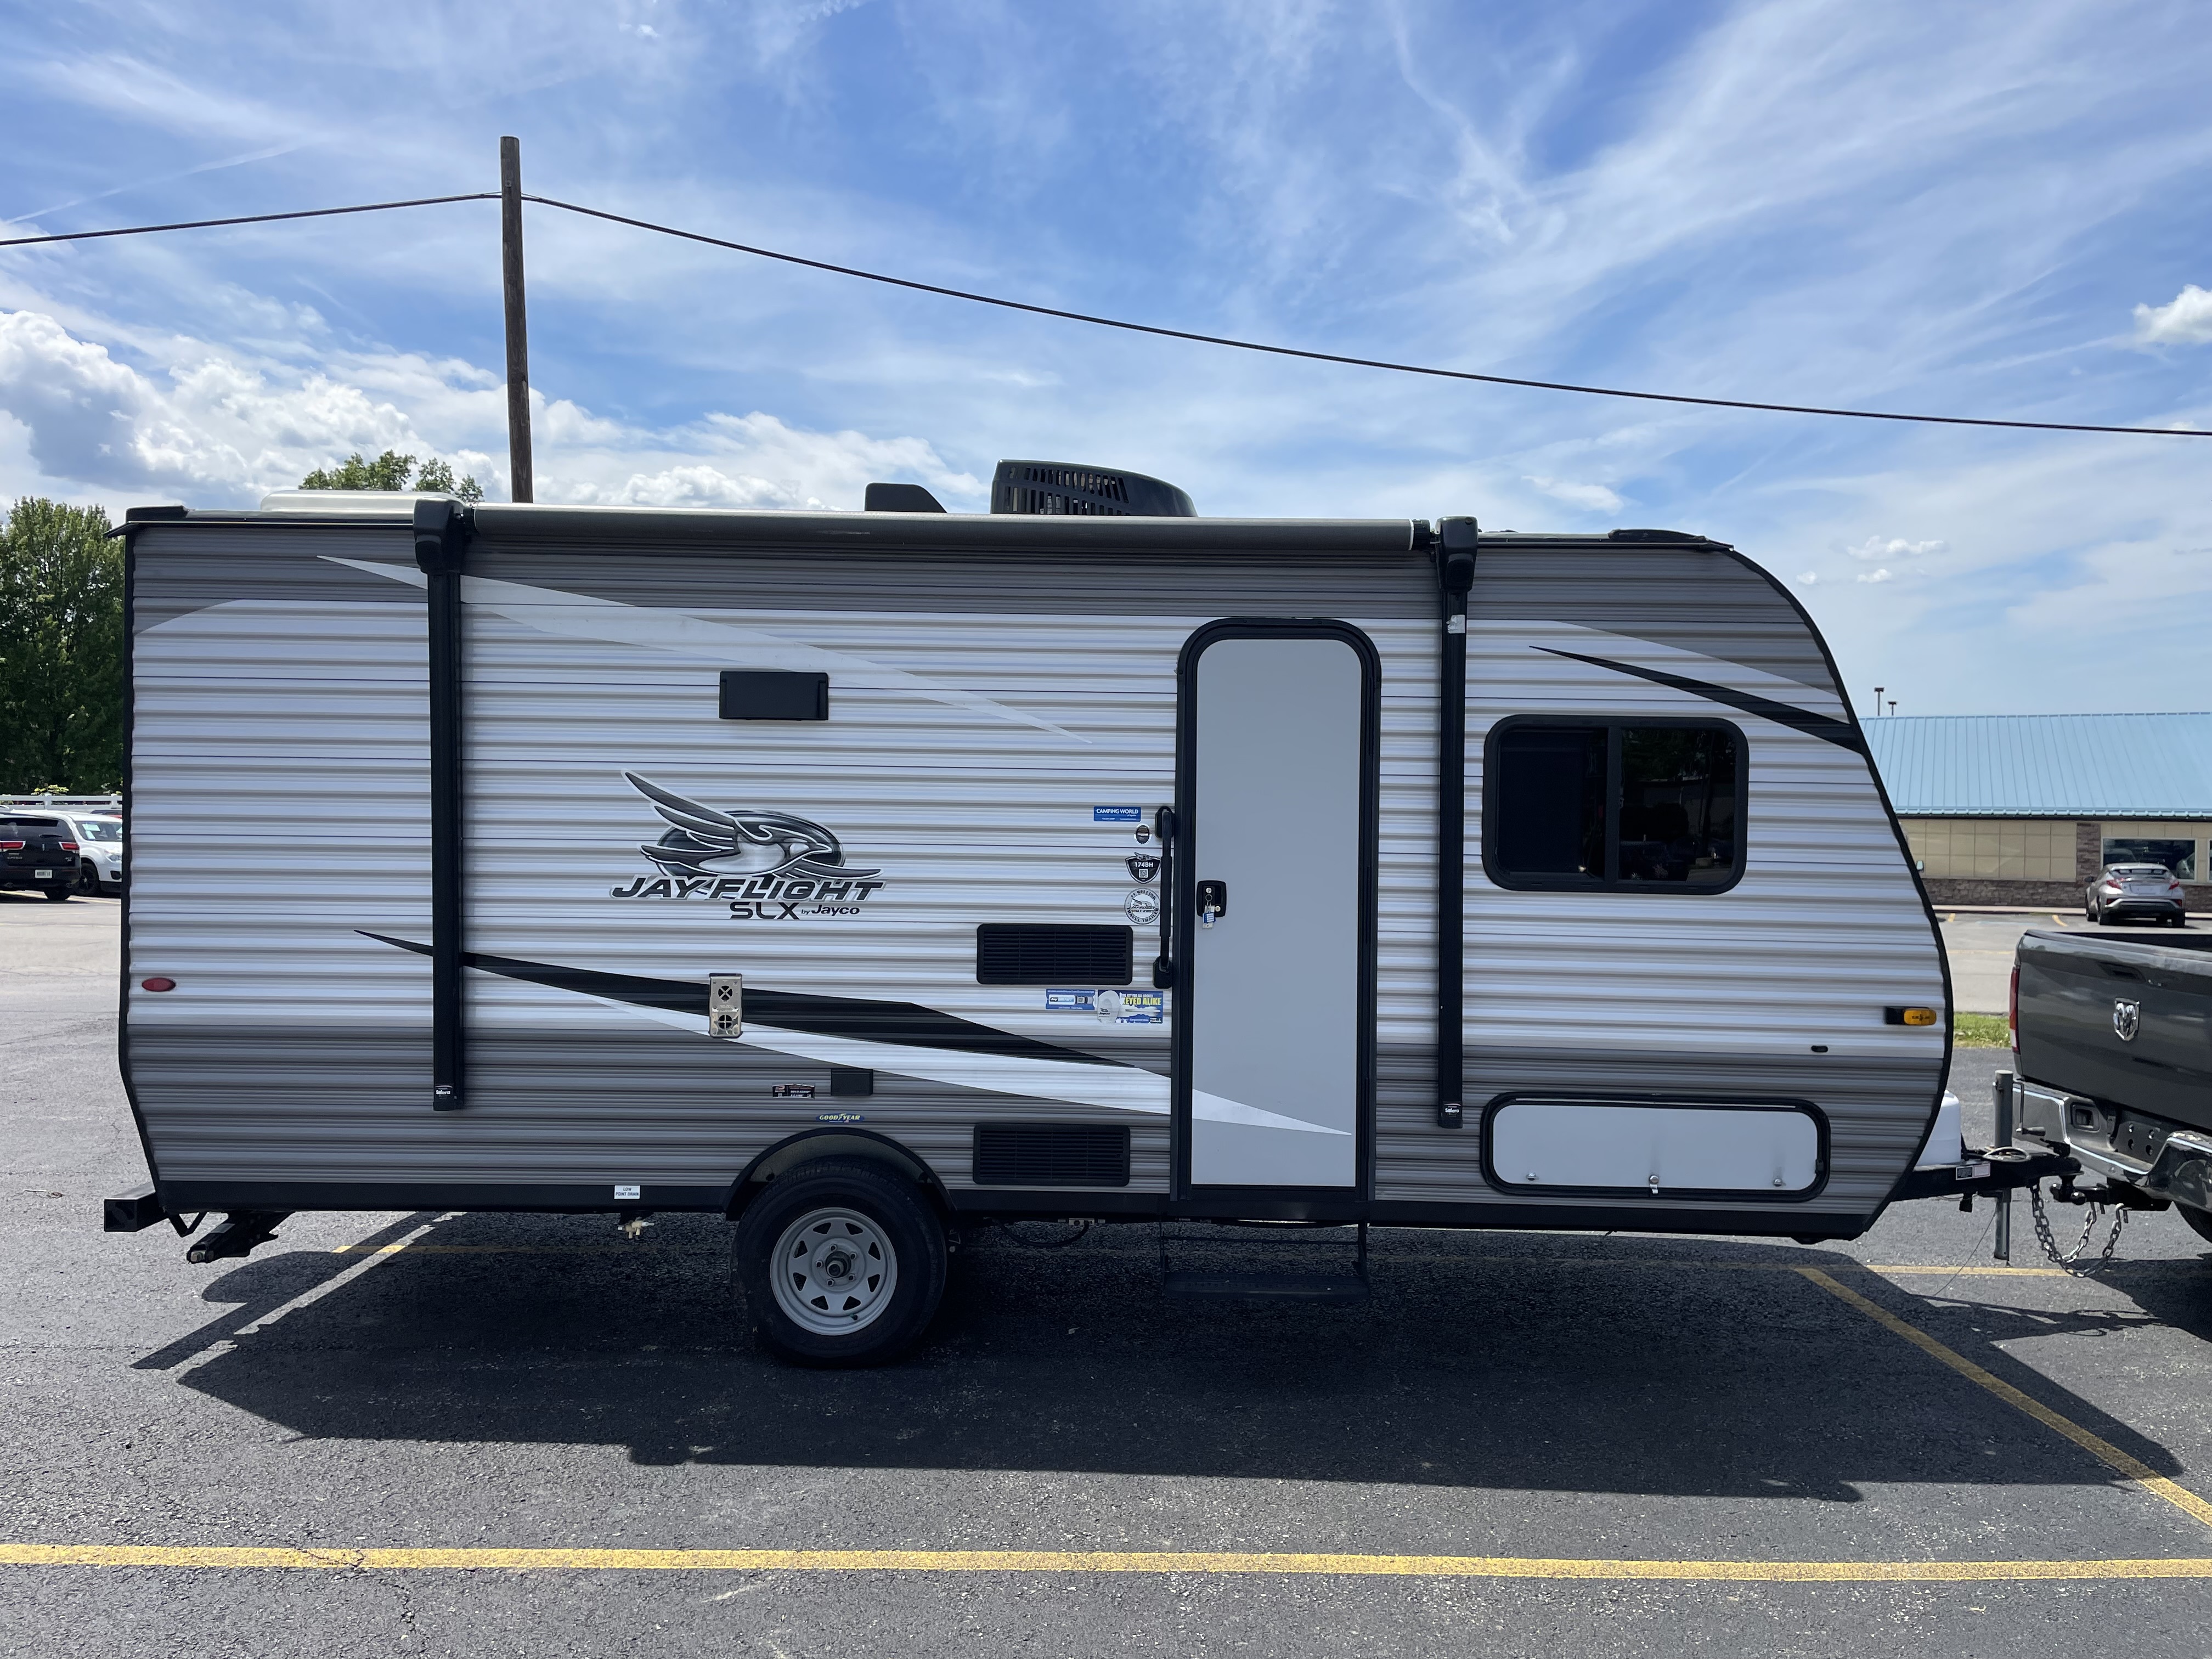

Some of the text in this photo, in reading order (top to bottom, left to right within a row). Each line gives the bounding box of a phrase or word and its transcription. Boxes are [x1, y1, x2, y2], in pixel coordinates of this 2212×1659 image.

[611, 876, 884, 901] JAY FLIGHT
[730, 901, 800, 920] SLX
[811, 904, 860, 917] Jayco
[1142, 997, 1161, 1006] ALIKE
